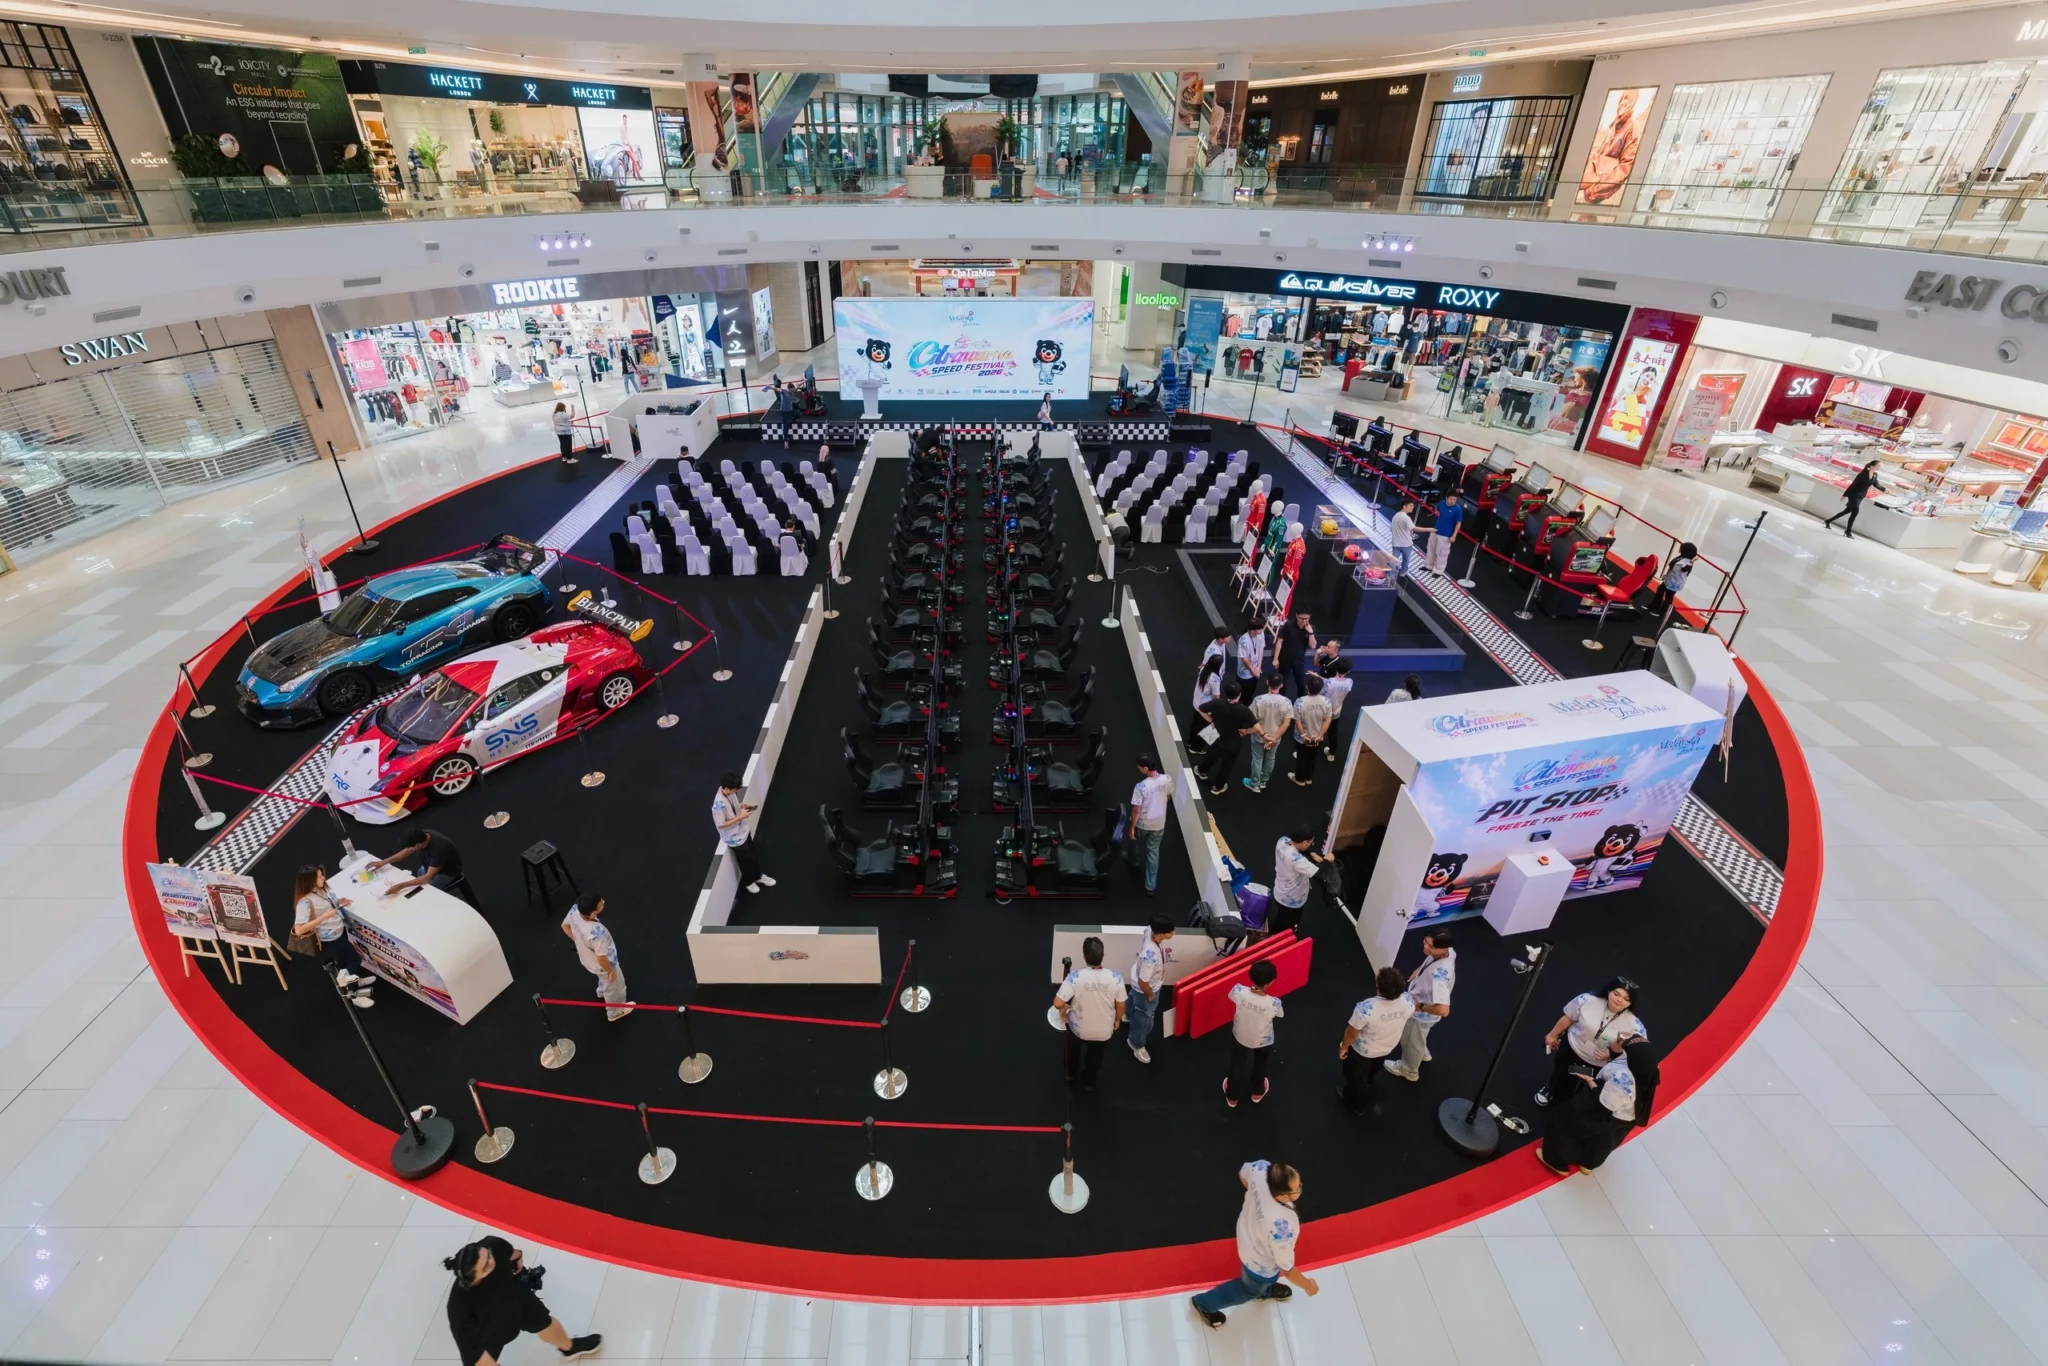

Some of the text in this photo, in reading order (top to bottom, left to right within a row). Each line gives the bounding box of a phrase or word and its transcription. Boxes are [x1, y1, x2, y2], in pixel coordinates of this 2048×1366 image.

[430, 73, 482, 90] HACKETT
[1454, 74, 1481, 88] RADO
[233, 83, 307, 99] Circular Impact
[572, 87, 616, 100] HACKETT
[226, 97, 321, 111] An ESG initiative that goes
[246, 109, 275, 121] beyond
[131, 157, 169, 165] COACH
[0, 266, 71, 305] OURT
[493, 277, 581, 305] ROOKIE
[1904, 270, 2001, 312] EAST
[1438, 286, 1500, 309] ROXY
[60, 331, 149, 366] S.WAN
[1578, 345, 1608, 357] ROX
[355, 360, 376, 371] KIDS
[931, 361, 1005, 375] SPEED FESTIVAL
[1842, 343, 1894, 379] SK
[977, 368, 1004, 377] 2026
[1787, 377, 1818, 395] SK
[575, 596, 640, 631] BLANCPAIN
[457, 615, 489, 635] GARAGE
[400, 641, 444, 668] TOPRACING
[1548, 694, 1636, 714] Malaysia
[485, 712, 539, 752] SNS
[1463, 718, 1524, 735] SPEED FESTIVAL
[1507, 723, 1527, 731] 2026
[489, 728, 541, 758] NETWORK
[332, 773, 351, 791] TRG
[1532, 766, 1605, 789] SPEED FESTIVAL
[1576, 773, 1601, 784] 2026
[1475, 784, 1619, 823] PIT STOP
[1486, 808, 1604, 833] FREEZE THE TIME!
[162, 891, 203, 902] REGISTRATION
[164, 898, 198, 908] COUNTER
[1380, 1011, 1406, 1022] CREW
